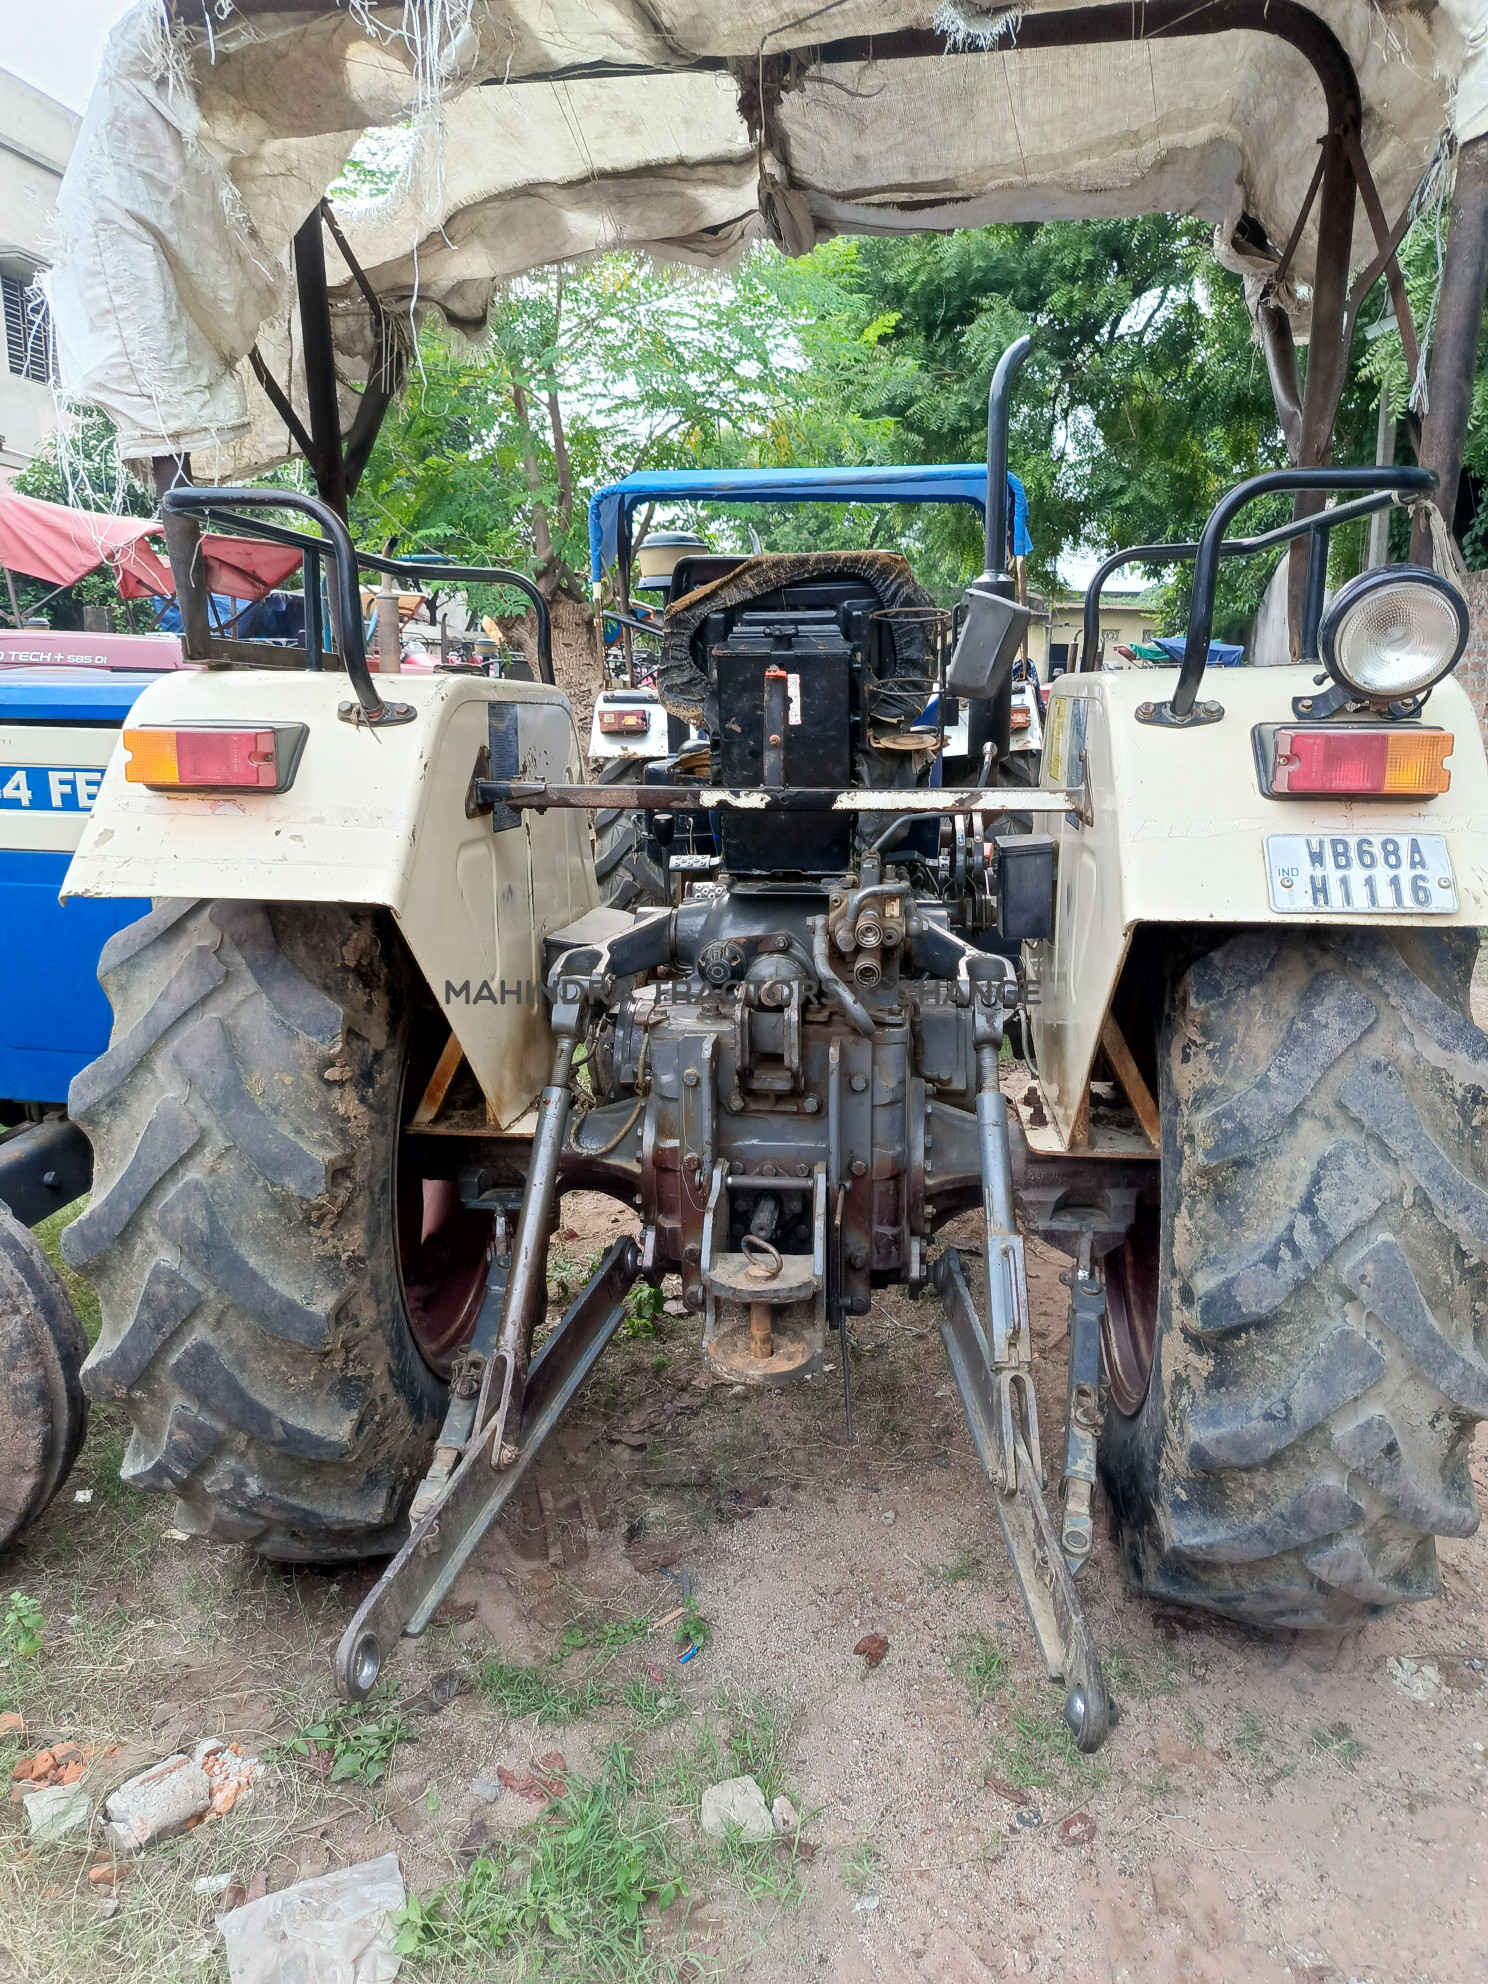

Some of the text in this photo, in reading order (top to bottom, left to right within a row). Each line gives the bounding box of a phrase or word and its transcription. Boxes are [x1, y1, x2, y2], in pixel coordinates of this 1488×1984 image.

[94, 656, 107, 664] DI
[0, 770, 32, 807] 4
[1305, 838, 1427, 870] WB68A
[1278, 867, 1299, 877] IND
[1310, 873, 1432, 907] H1116
